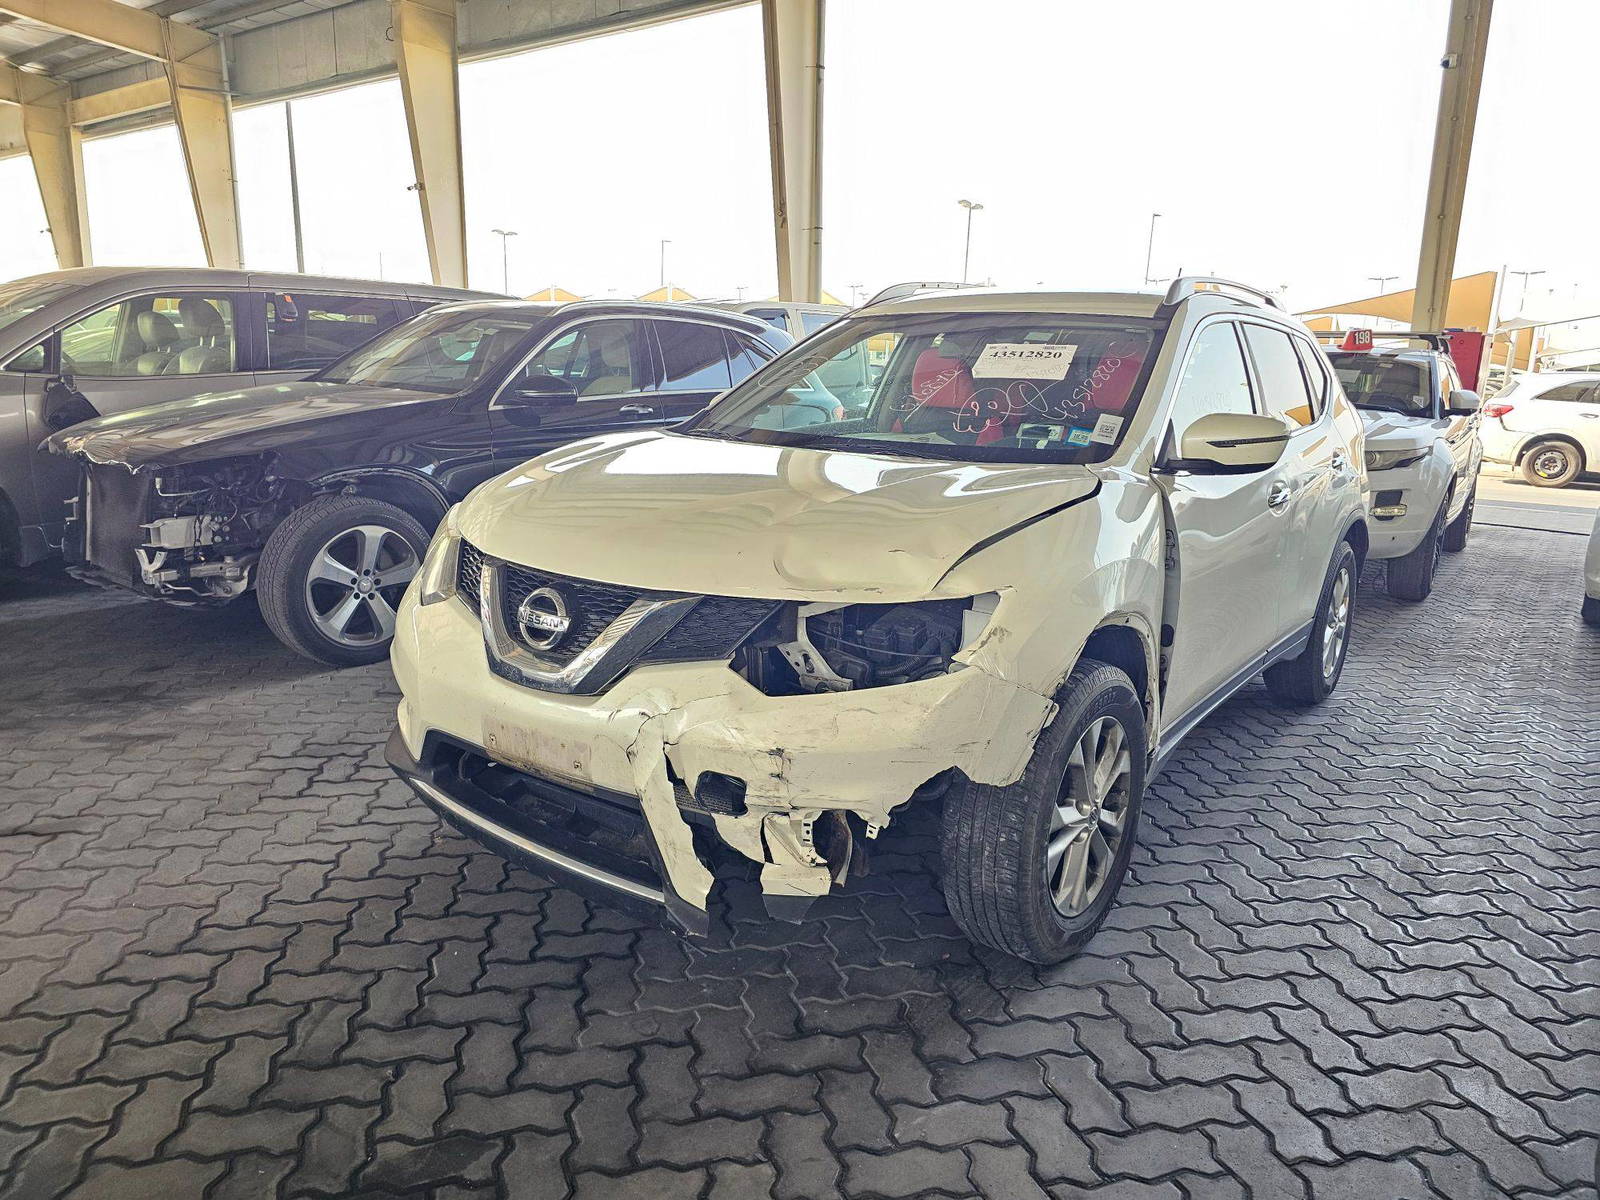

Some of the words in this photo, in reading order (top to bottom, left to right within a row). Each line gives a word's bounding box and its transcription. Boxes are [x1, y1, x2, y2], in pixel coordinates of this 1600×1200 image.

[1354, 331, 1370, 345] 198
[990, 351, 1062, 359] 43512820
[518, 607, 559, 628] NISSAN
